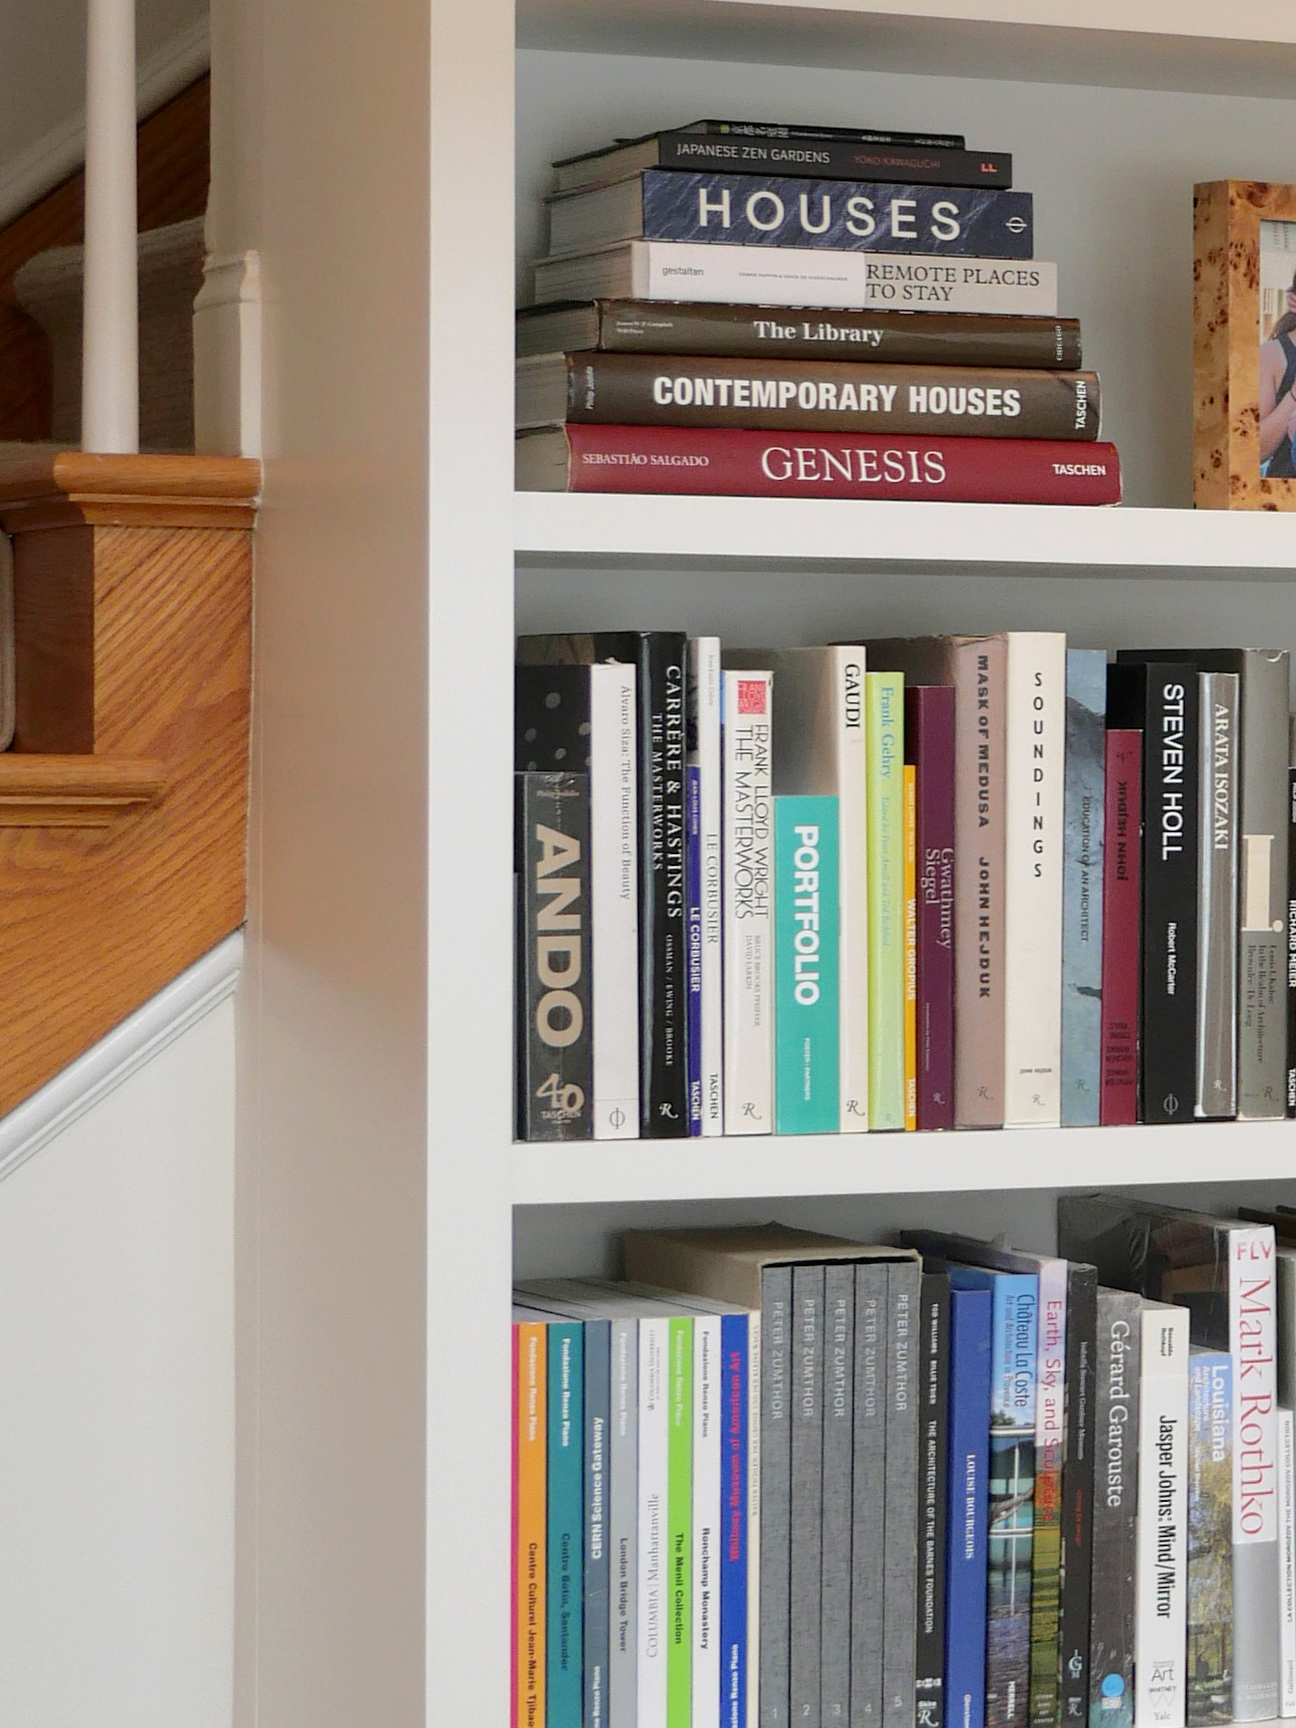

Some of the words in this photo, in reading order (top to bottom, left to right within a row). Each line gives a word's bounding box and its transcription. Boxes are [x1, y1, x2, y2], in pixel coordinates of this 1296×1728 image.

[677, 143, 739, 158] JAPANESE
[742, 146, 767, 160] ZEN
[771, 149, 831, 165] GARDENS
[698, 188, 962, 241] HOUSES
[662, 266, 704, 276] gestalten
[867, 265, 956, 283] REMOTE
[964, 268, 1040, 287] PLACES
[869, 283, 895, 299] TO
[903, 285, 953, 301] STAY
[753, 320, 796, 340] The
[804, 324, 884, 347] Library
[653, 376, 897, 411] CONTEMPORARY
[909, 386, 1020, 416] HOUSES
[1075, 380, 1087, 429] TASCHEN
[650, 455, 708, 466] SALGADO
[761, 446, 946, 484] GENESIS
[1053, 464, 1106, 476] TASCHEN
[845, 664, 860, 729] GAUDI
[881, 686, 895, 727] Frank
[979, 655, 989, 710] MASK
[652, 713, 663, 743] THE
[666, 665, 687, 771] CARRÈRE
[735, 725, 752, 761] THE
[979, 716, 989, 739] OF
[1163, 684, 1183, 783] STEVEN
[1215, 705, 1229, 768] ARATA
[754, 724, 768, 776] FRANK
[878, 733, 894, 778] Gehry
[653, 750, 663, 871] MASTERWORKS
[666, 781, 680, 793] &
[754, 785, 768, 840] LLOYD
[979, 745, 990, 827] MEDUSA
[1215, 772, 1229, 849] ISOZAKI
[707, 833, 719, 850] LE
[735, 770, 753, 919] MASTERWORKS
[1163, 793, 1183, 860] HOLL
[667, 805, 683, 918] HASTINGS
[754, 847, 768, 919] WRIGHT
[923, 849, 940, 905] Siegel
[979, 857, 990, 909] JOHN
[707, 855, 719, 943] CORBUSIER
[795, 826, 819, 1005] PORTFOLIO
[938, 847, 953, 949] Gwathmey
[536, 824, 584, 1047] ANDO
[979, 916, 990, 998] HEJDUK
[710, 1074, 719, 1118] TASCHEN
[896, 1294, 908, 1338] PETER
[1015, 1294, 1035, 1346] Château
[1240, 1275, 1273, 1379] Mark
[896, 1342, 908, 1411] ZUMTHOR
[1015, 1352, 1033, 1366] La
[1110, 1320, 1130, 1400] Gérard
[1015, 1371, 1032, 1407] Coste
[1212, 1364, 1227, 1461] Louisiana
[1107, 1405, 1126, 1506] Garouste
[1155, 1415, 1177, 1467] Jasper
[1240, 1393, 1273, 1534] Rothko
[966, 1454, 976, 1493] LOUISE
[1158, 1470, 1176, 1521] Johns:
[965, 1496, 976, 1559] BOURGEOIS
[700, 1527, 711, 1587] Ronchamp
[1156, 1525, 1176, 1618] Mind/Mirror
[699, 1591, 710, 1649] Monastery
